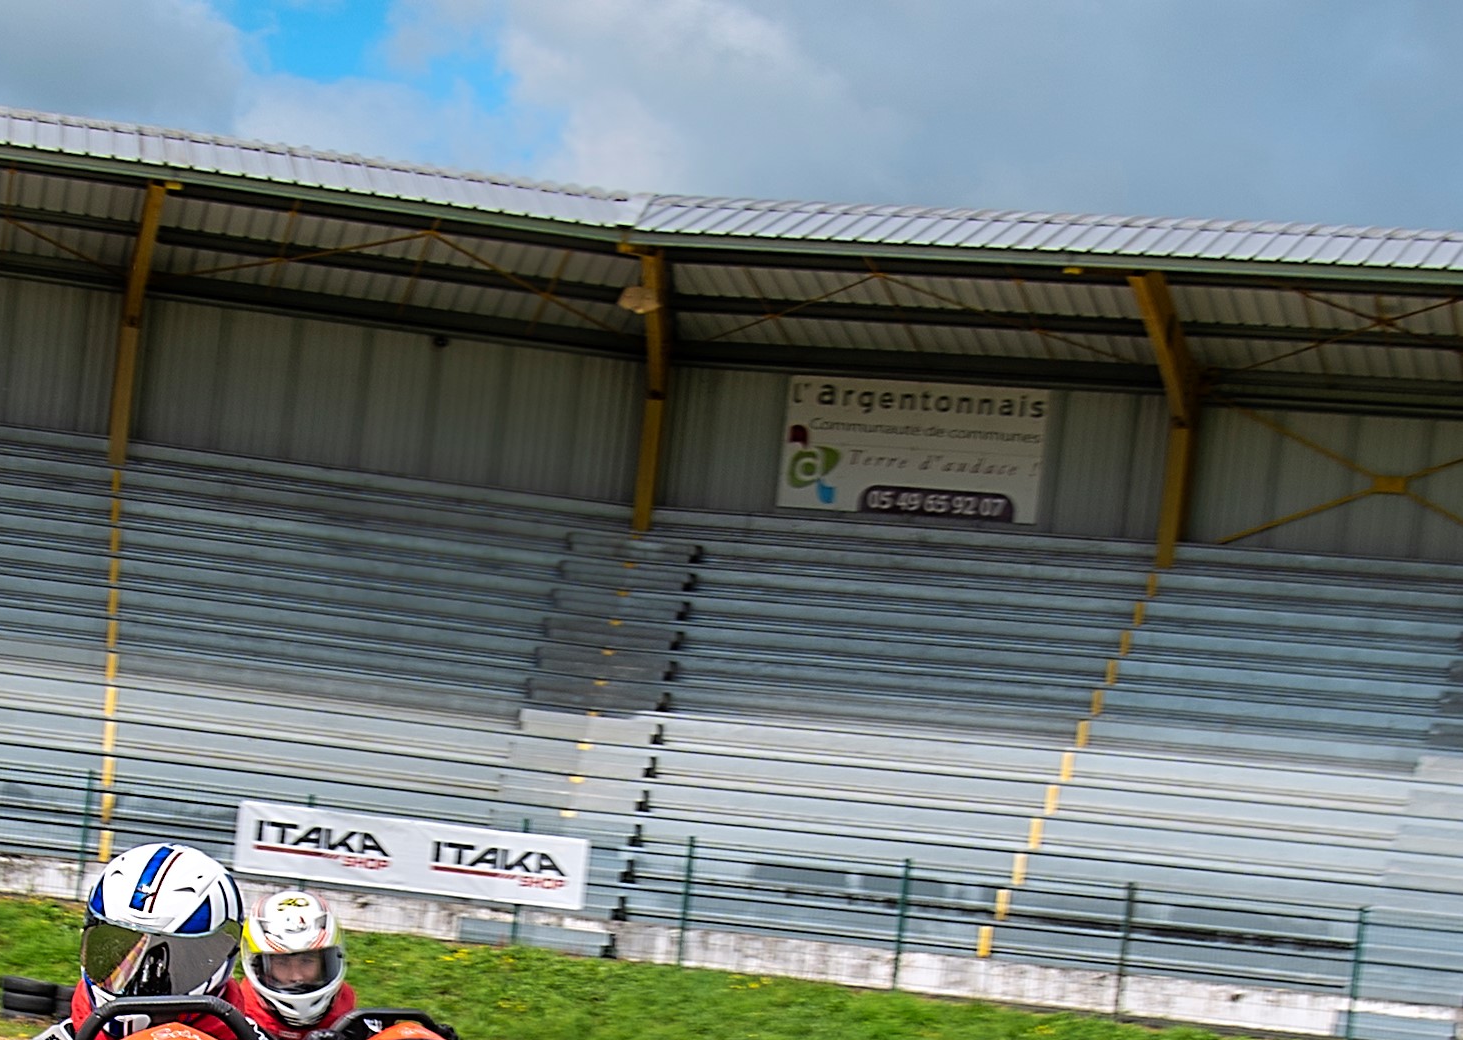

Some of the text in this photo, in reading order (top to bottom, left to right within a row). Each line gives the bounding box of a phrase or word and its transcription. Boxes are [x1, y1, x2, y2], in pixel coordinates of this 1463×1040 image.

[848, 449, 907, 469] Terre
[867, 490, 1006, 517] 05 49 65 92 07
[255, 819, 391, 857] ITAKA
[341, 856, 390, 870] SHOP
[433, 840, 567, 877] ITAKA
[519, 876, 566, 890] SHOP
